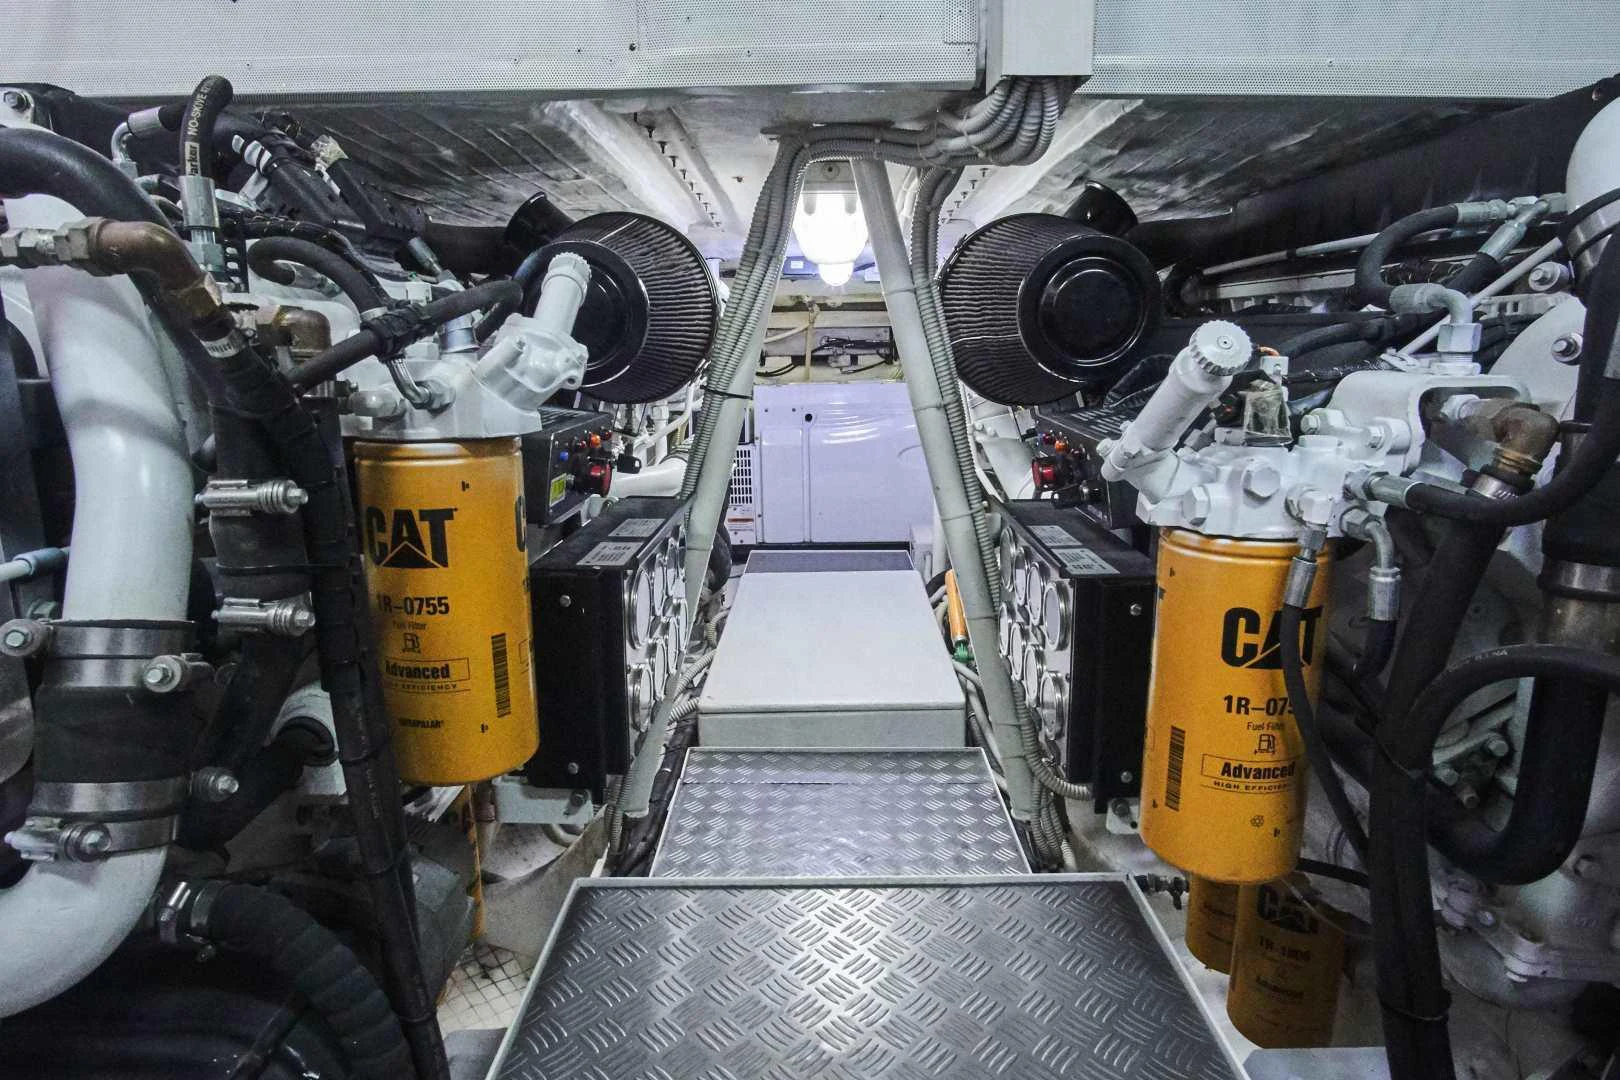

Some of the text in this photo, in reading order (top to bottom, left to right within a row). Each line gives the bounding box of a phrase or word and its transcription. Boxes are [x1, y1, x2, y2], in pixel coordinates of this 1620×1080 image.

[366, 507, 454, 568] CAT
[385, 661, 450, 680] Advanced
[1223, 694, 1293, 716] 1R-07
[1221, 761, 1296, 780] Advanced
[1214, 780, 1240, 790] HIGH
